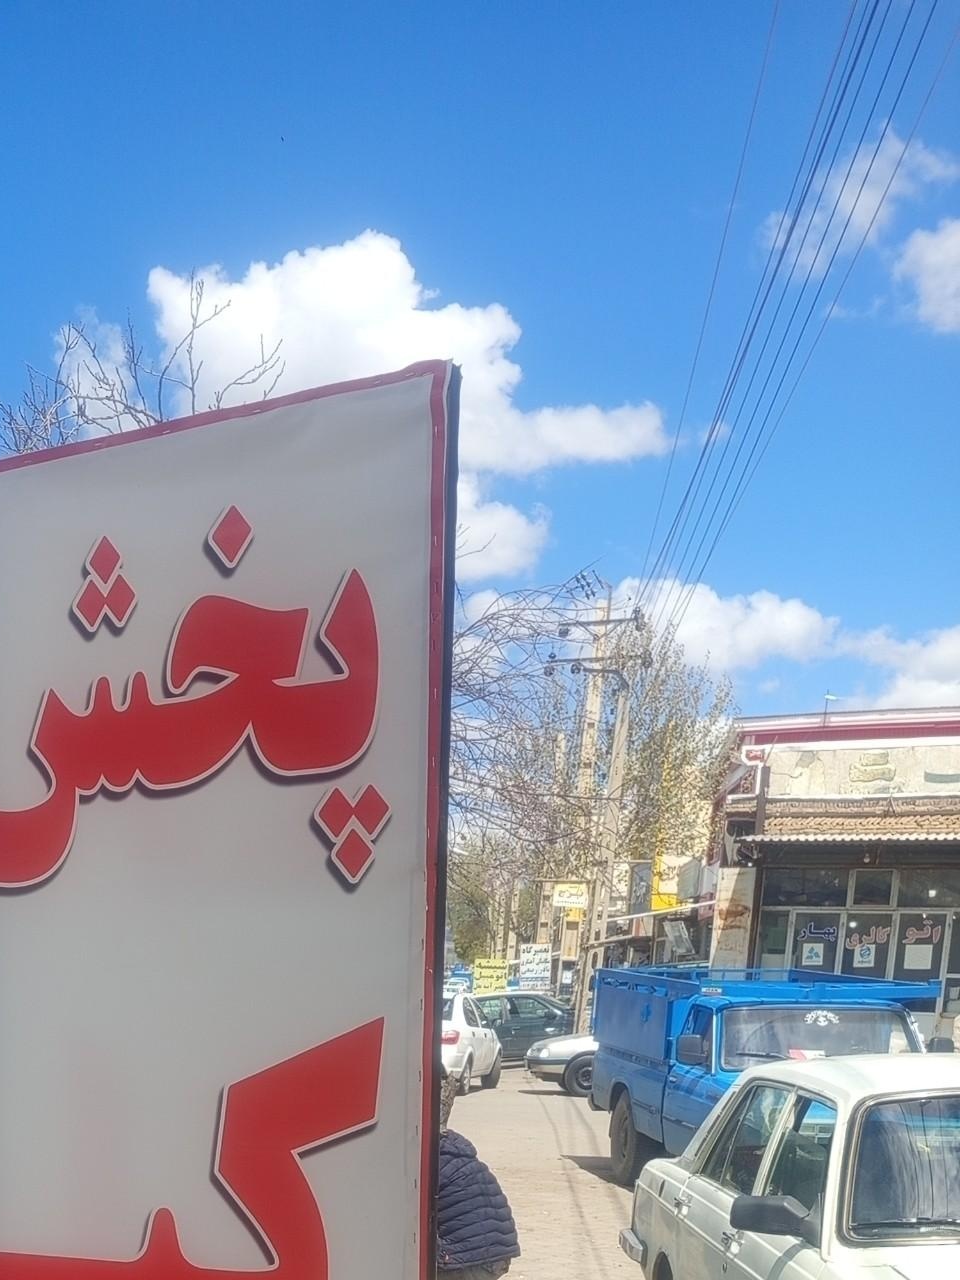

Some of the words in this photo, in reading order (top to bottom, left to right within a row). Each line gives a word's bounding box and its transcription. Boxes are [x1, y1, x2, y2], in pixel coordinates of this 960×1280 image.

[797, 922, 837, 943] بهار
[846, 926, 891, 950] گالری
[902, 920, 941, 944] اتو
